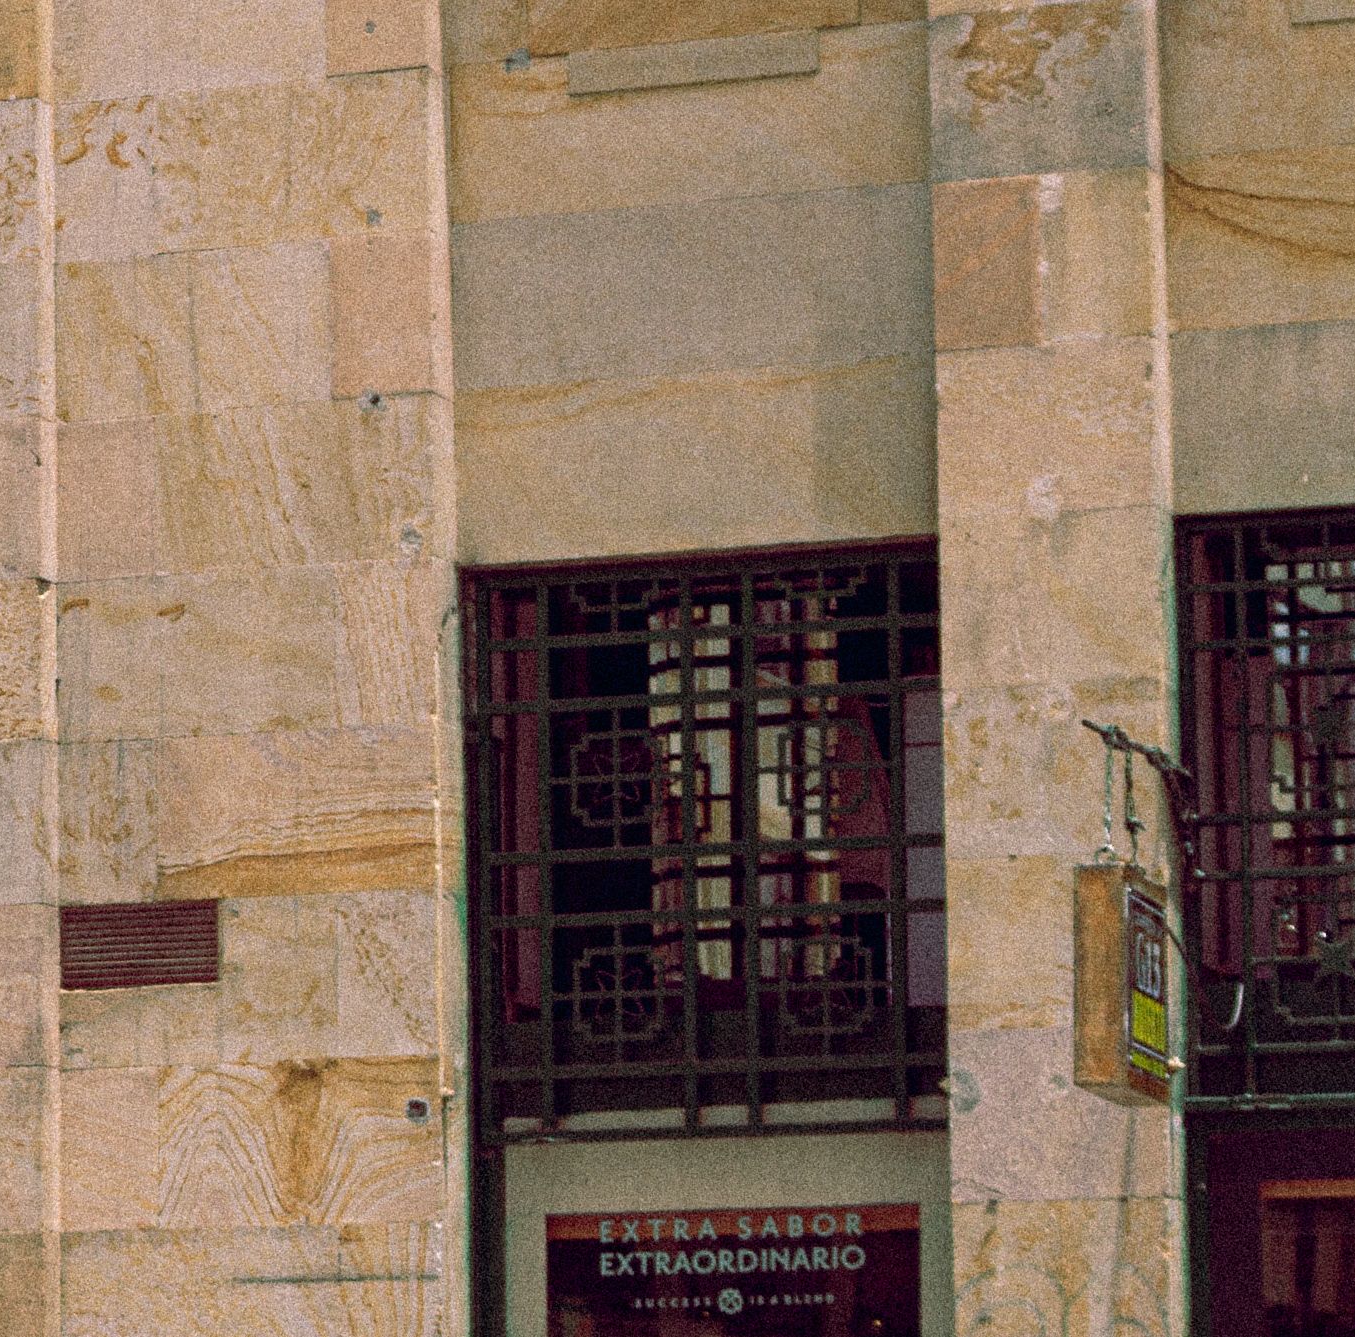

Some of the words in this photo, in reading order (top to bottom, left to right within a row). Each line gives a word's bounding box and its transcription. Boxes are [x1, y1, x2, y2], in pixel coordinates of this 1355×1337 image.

[599, 1216, 717, 1244] EXTRA
[738, 1212, 864, 1241] SABOR
[600, 1245, 867, 1277] EXTRAORDINARIO
